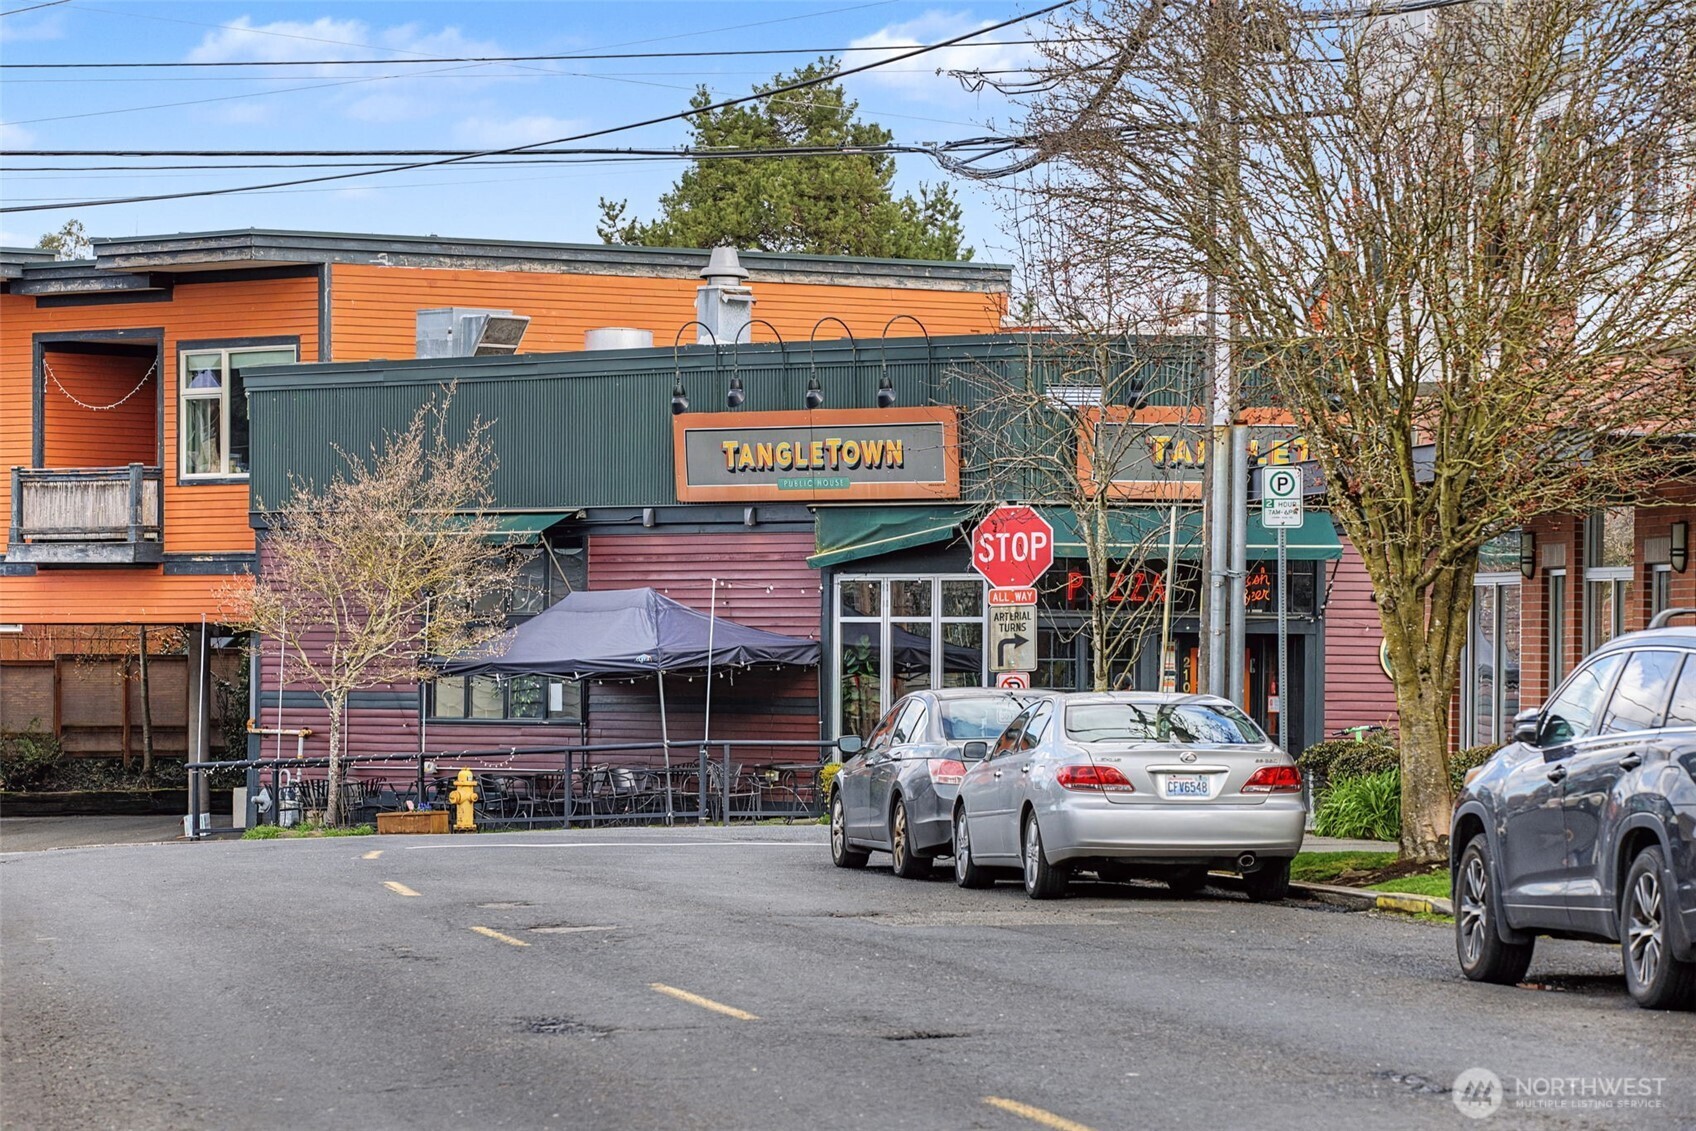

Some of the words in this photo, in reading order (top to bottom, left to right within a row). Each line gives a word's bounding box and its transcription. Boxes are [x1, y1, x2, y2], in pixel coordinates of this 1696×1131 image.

[783, 480, 813, 488] PUBLIC
[817, 479, 844, 487] HOUSE
[1277, 476, 1288, 491] P
[1264, 500, 1273, 508] 2
[978, 532, 1047, 563] STOP
[1067, 572, 1167, 602] PZZA
[993, 593, 1009, 602] ALL
[1014, 592, 1033, 601] WAY
[993, 611, 1032, 621] ARTERIAL
[999, 622, 1027, 632] TURNS
